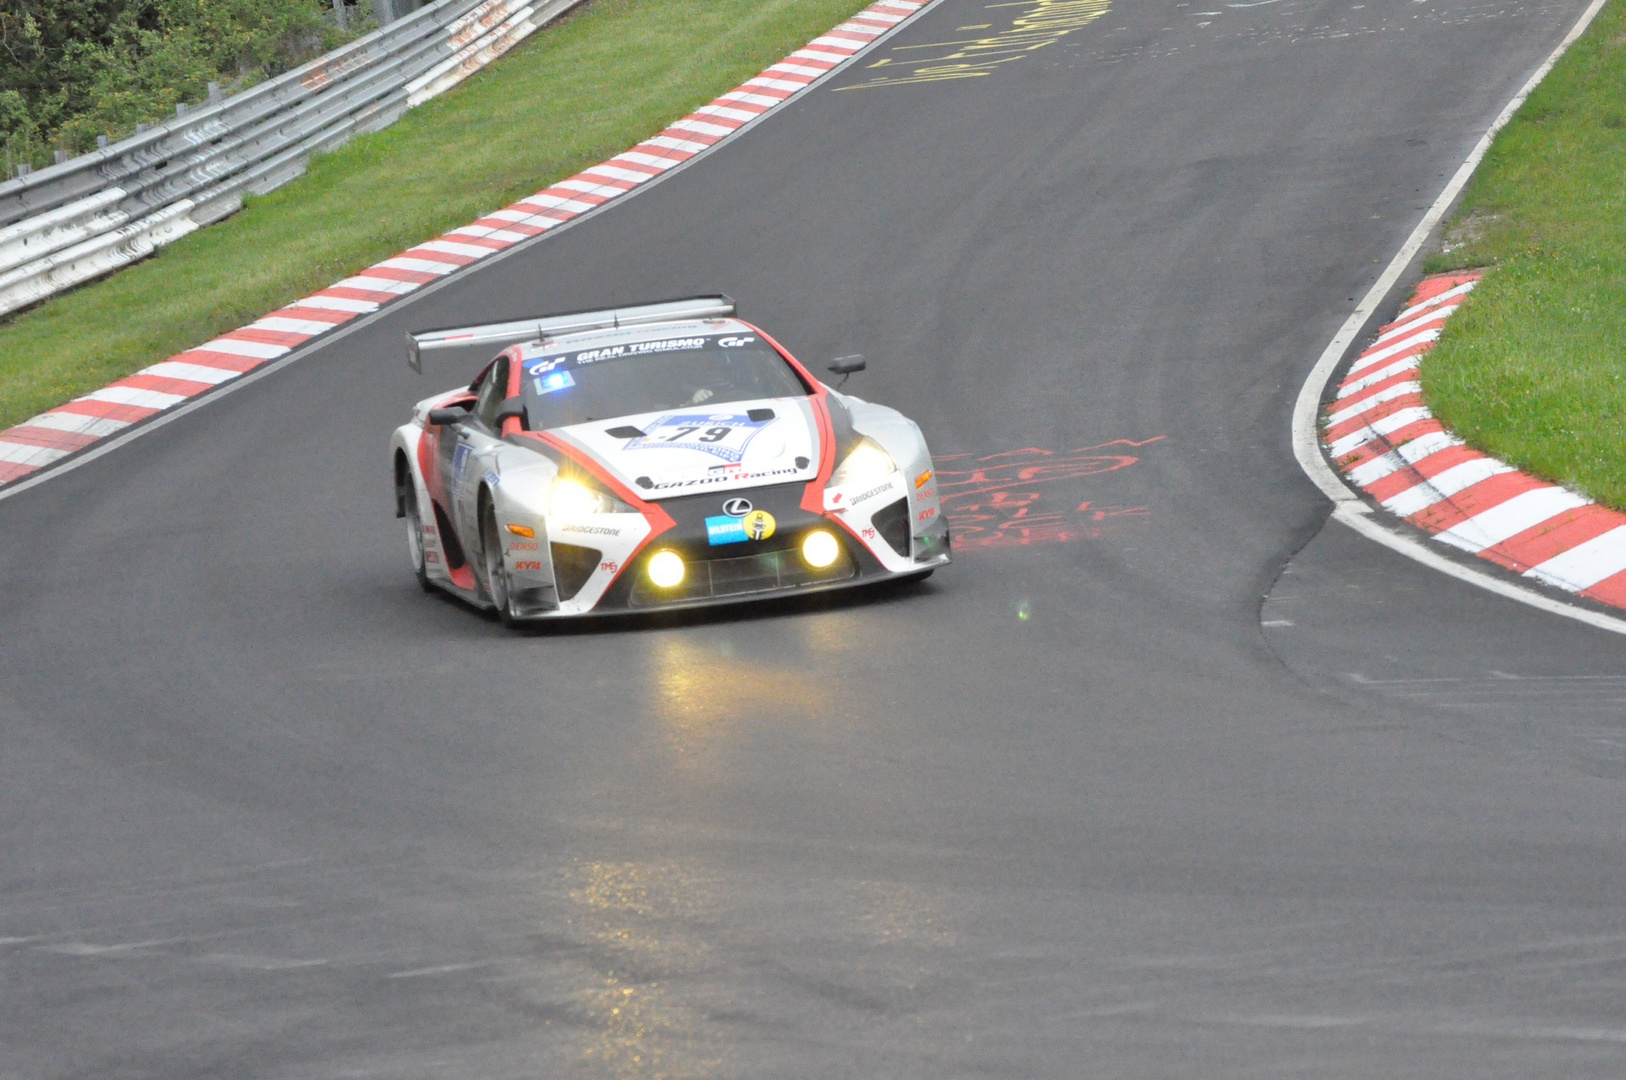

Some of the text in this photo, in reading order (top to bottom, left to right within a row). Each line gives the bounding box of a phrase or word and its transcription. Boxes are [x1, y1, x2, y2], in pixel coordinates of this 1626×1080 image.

[577, 337, 705, 361] GRAN TURISMO
[595, 355, 617, 363] REAL
[619, 349, 651, 358] DRIVING
[654, 345, 703, 353] SIMULATOR
[665, 426, 732, 442] 79
[654, 467, 797, 490] GAZOO Racing
[850, 482, 894, 505] BRIDGESTONE
[562, 524, 621, 536] BRIDGESTONE
[708, 521, 743, 535] BILSTEIN
[510, 542, 539, 551] DENSO
